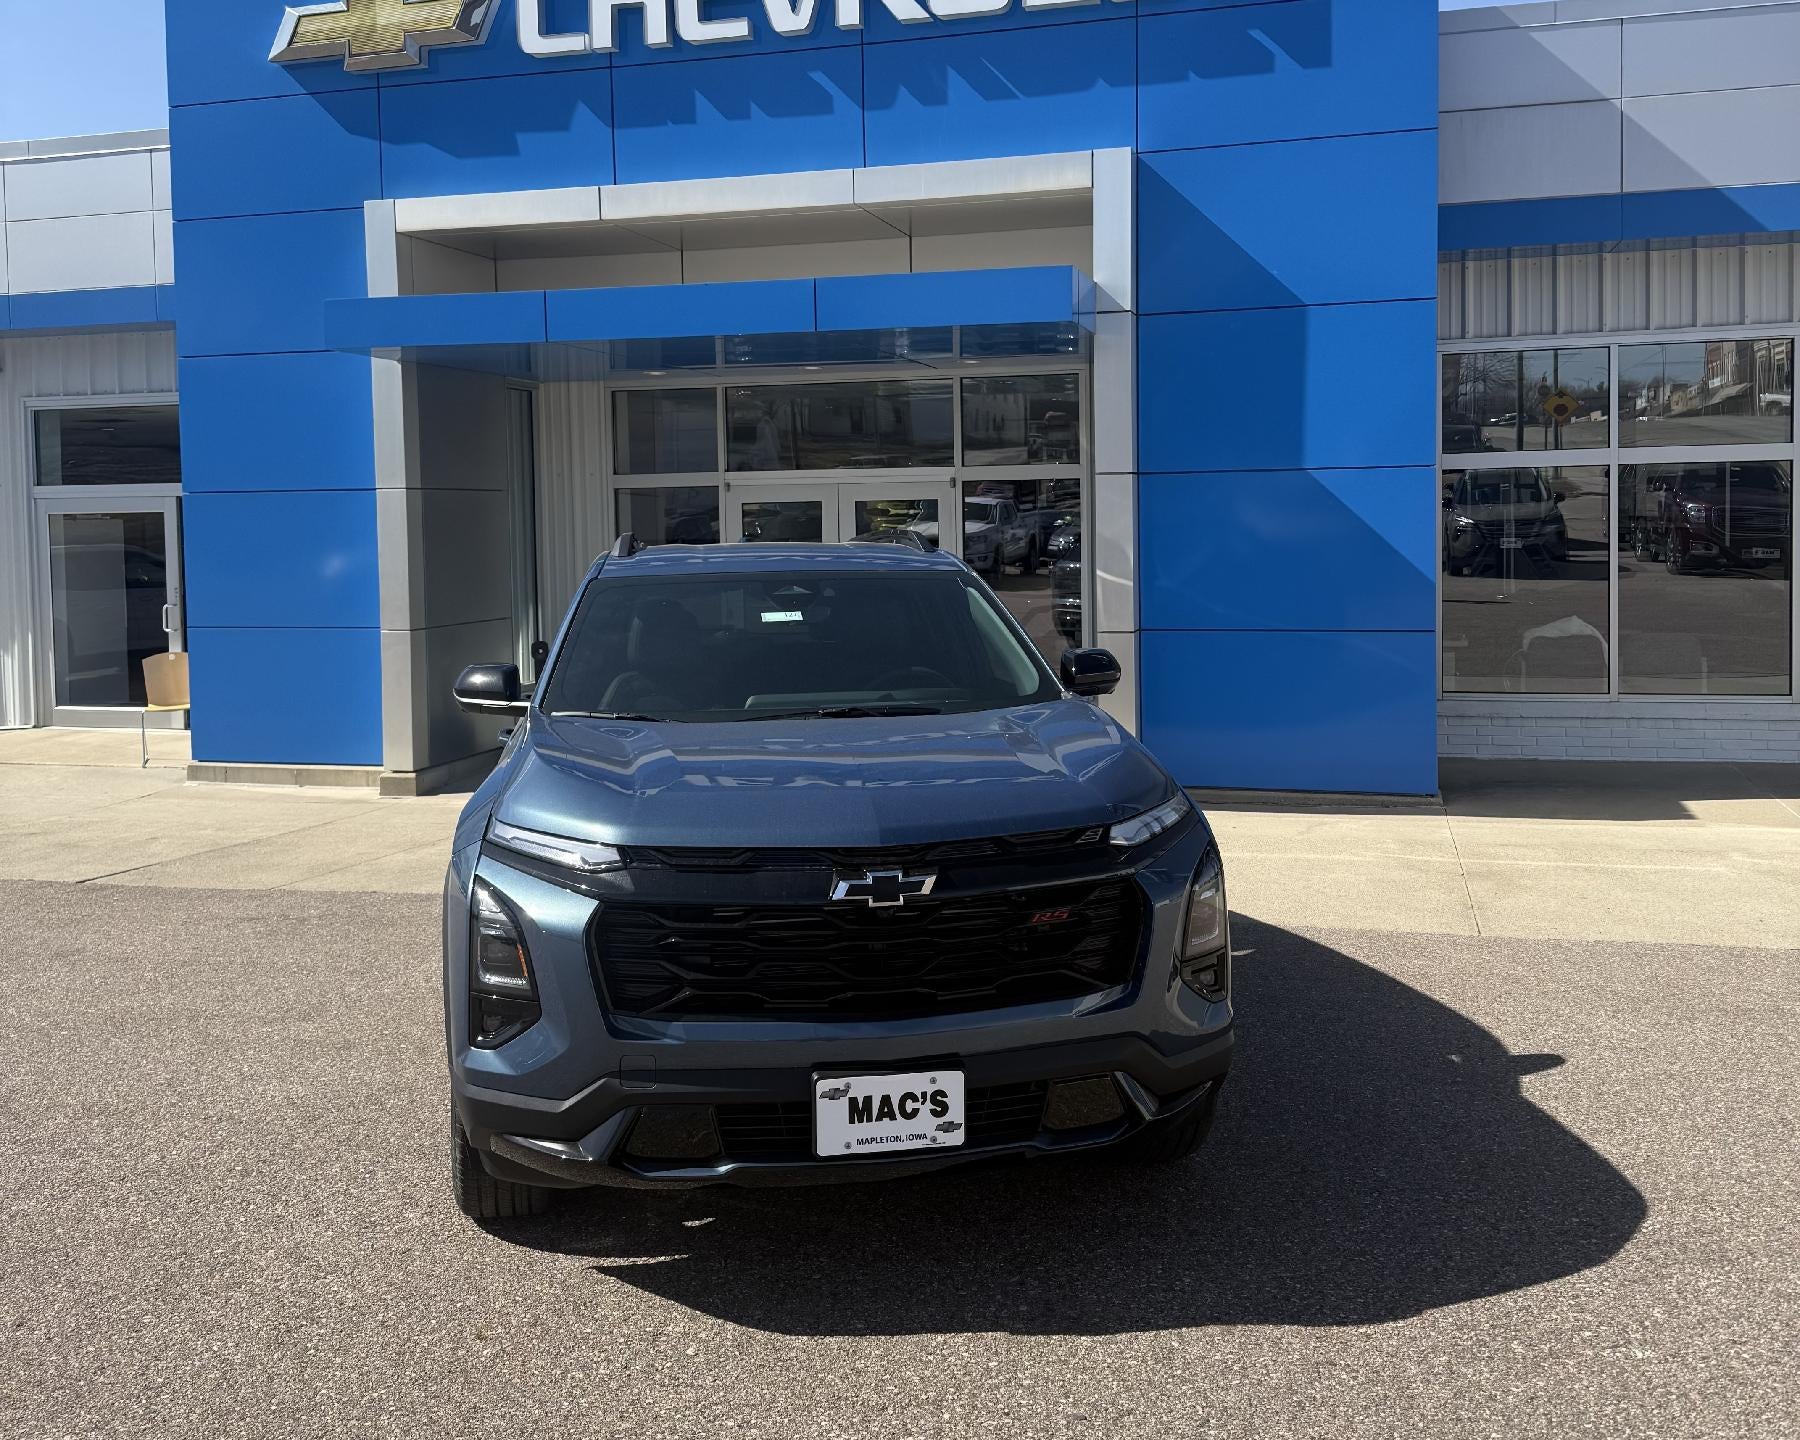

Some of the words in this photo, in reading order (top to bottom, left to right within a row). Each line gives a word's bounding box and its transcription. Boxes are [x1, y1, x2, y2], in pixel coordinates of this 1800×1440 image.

[1032, 908, 1072, 924] RS
[848, 1089, 949, 1124] MAC'S
[856, 1134, 905, 1146] MAPLETON,
[905, 1132, 928, 1142] IOWA
